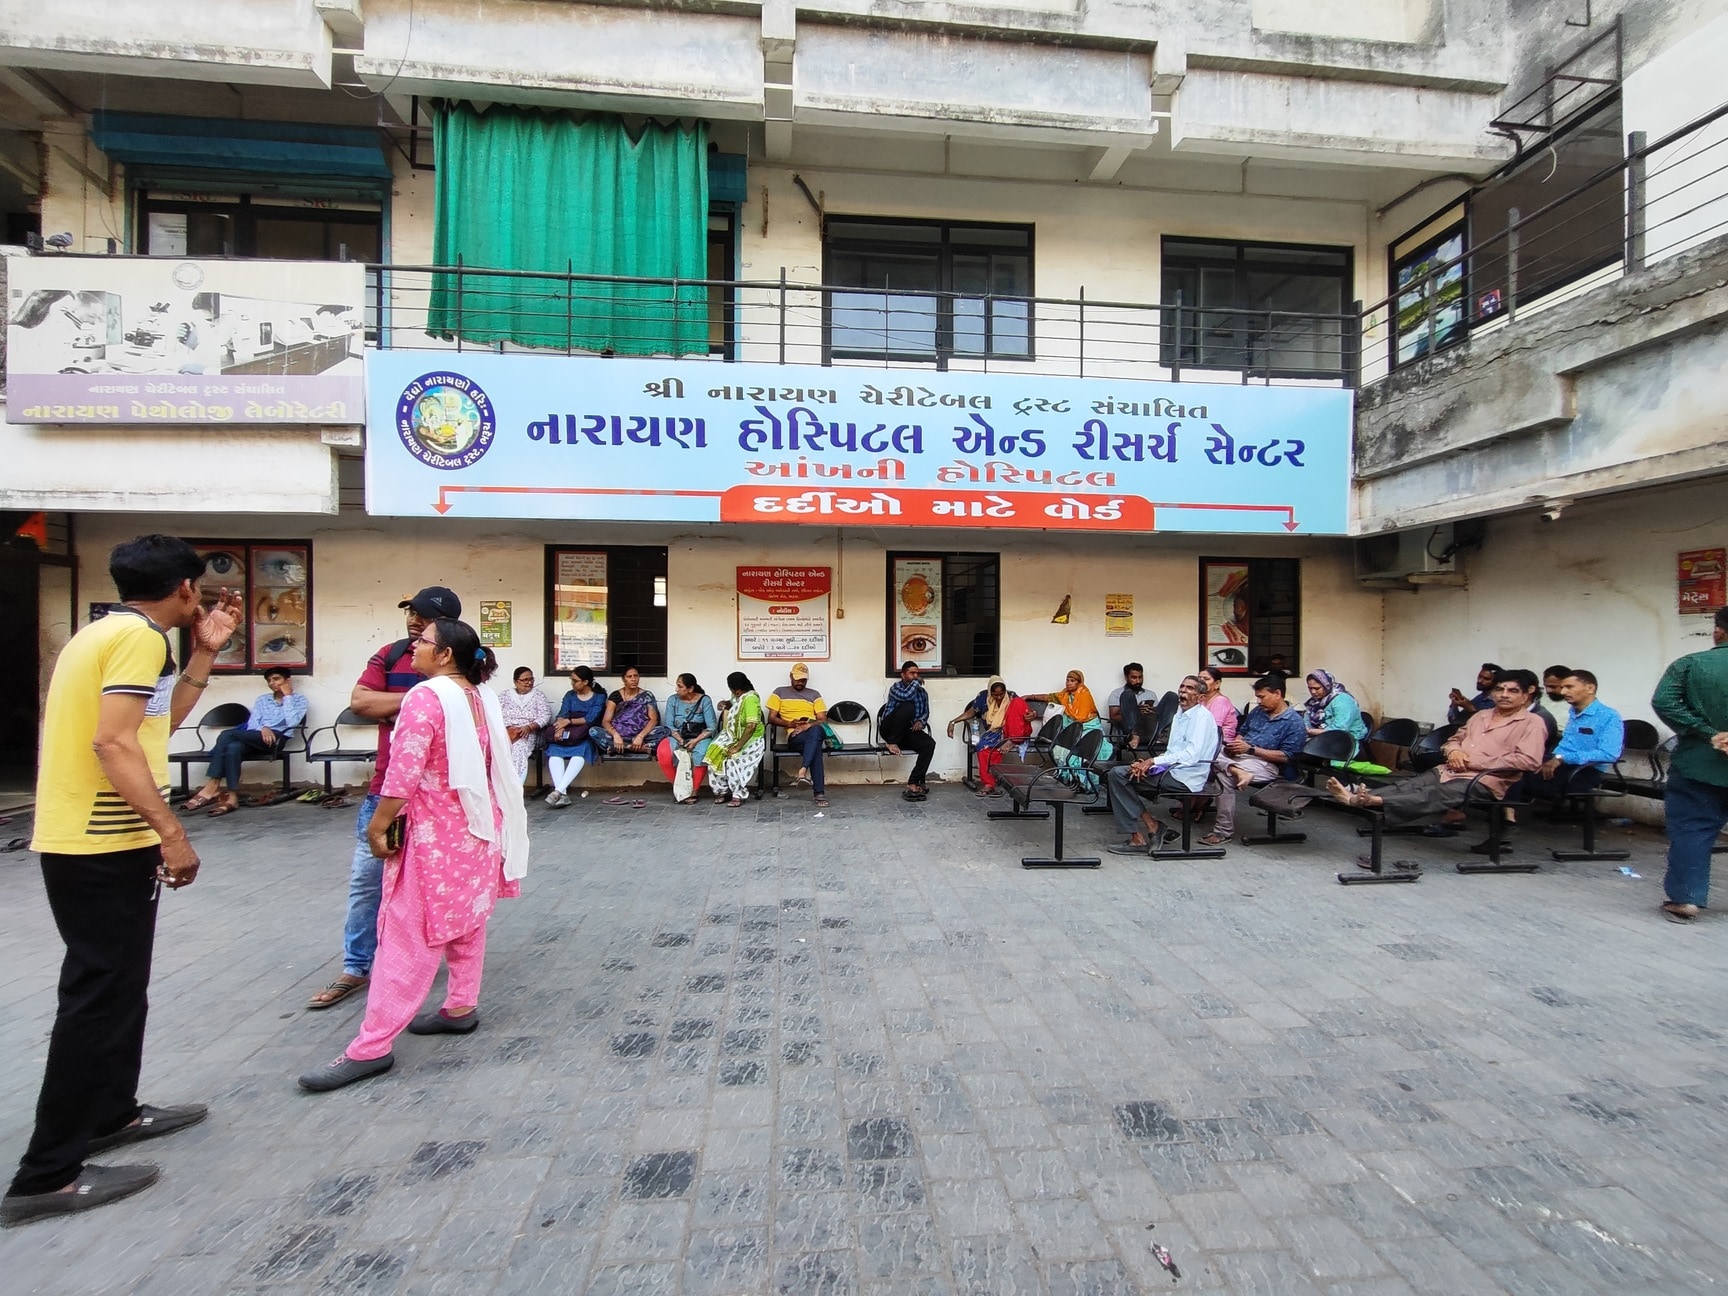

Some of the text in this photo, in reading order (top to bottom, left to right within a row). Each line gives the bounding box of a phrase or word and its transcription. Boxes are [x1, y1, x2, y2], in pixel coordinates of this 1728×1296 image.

[88, 385, 139, 394] નારાયણ
[144, 382, 198, 394] ચેરીટેબલ
[234, 383, 286, 395] સંચાલિત
[642, 377, 1208, 419] શ્રી નારાયણ ચેરીટેબલ ટ્રસ્ટ સંચાલિત
[22, 399, 348, 421] નારાયણ પેથોલોજી લેબોરેટરી
[527, 405, 1306, 467] નારાયણ હોસ્પિટલ એન્ડ રીસર્ચ સેન્ટર
[744, 456, 1117, 487] આંખની હોસ્પિટલ
[753, 491, 1125, 521] દર્દીઓ માટે વોર્ડ
[742, 568, 826, 578] નારાયણ હોસ્પિટલ એન્ડ
[785, 578, 805, 587] સેન્ટર
